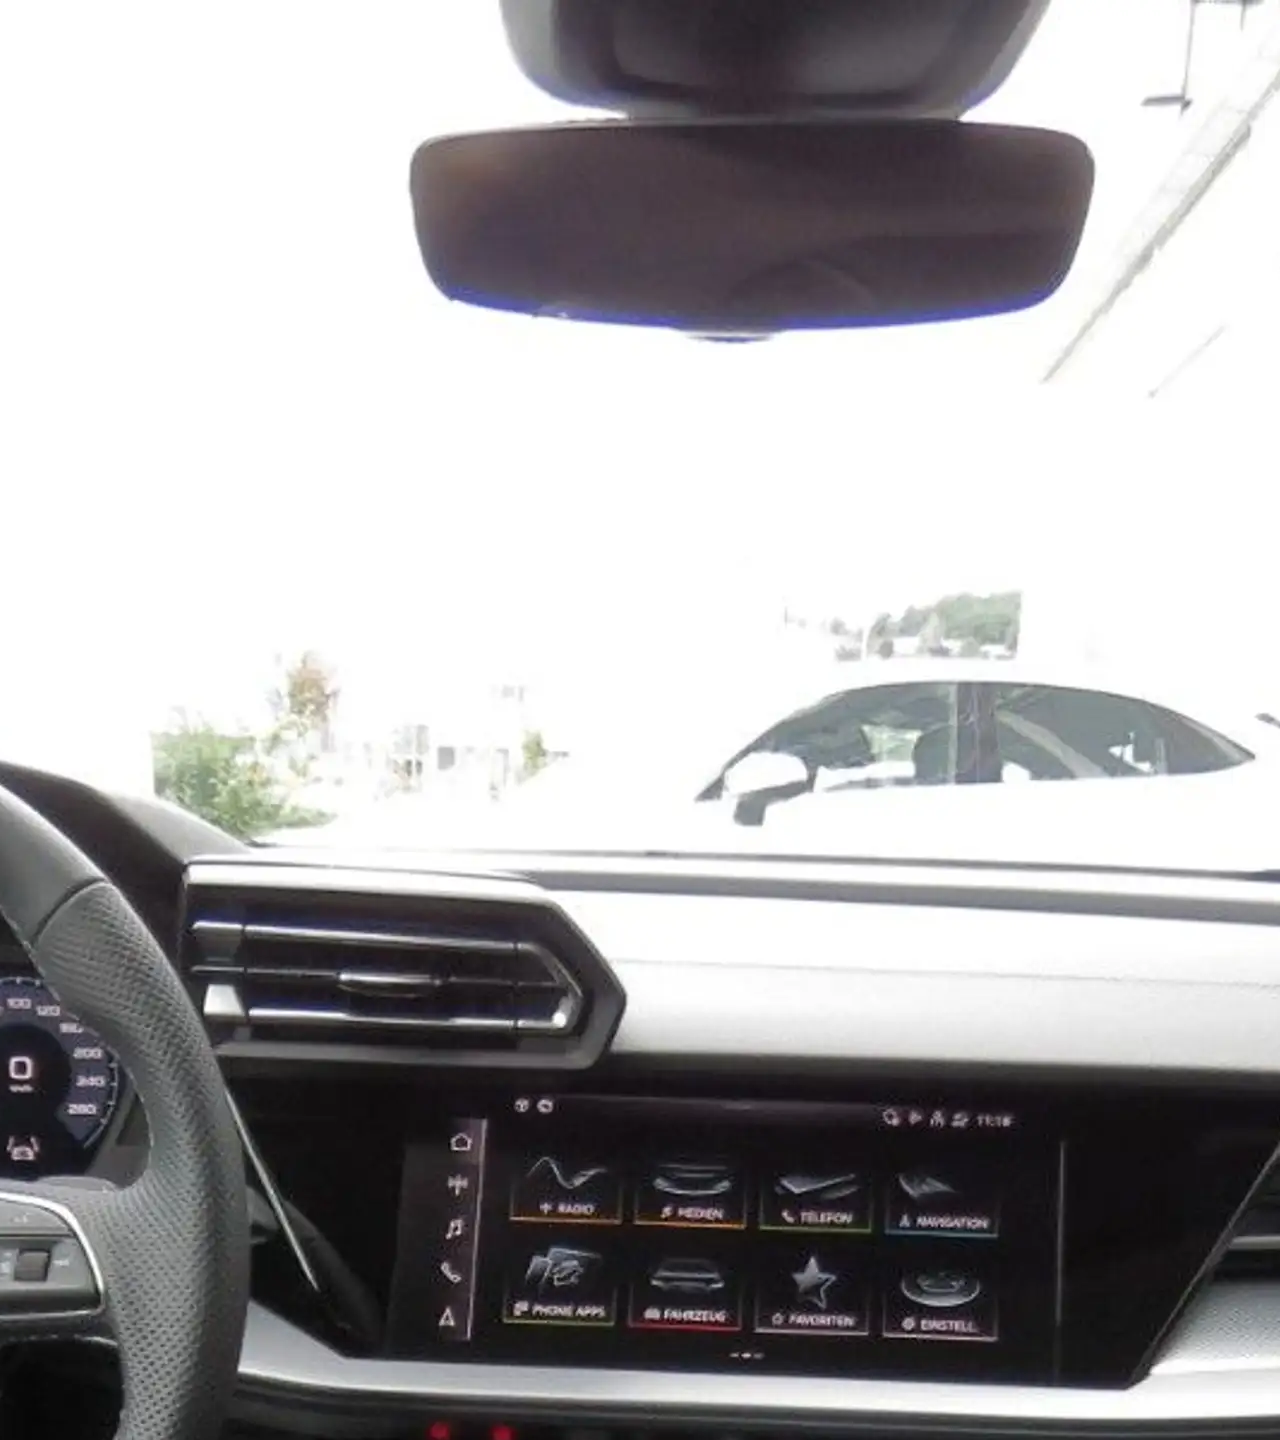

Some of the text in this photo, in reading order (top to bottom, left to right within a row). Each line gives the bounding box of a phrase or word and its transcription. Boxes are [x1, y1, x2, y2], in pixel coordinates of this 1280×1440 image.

[6, 998, 32, 1010] 100
[36, 1005, 61, 1017] 120
[73, 1048, 103, 1060] 200
[7, 1055, 35, 1081] 0
[76, 1076, 106, 1088] 240
[558, 1202, 596, 1216] RADIO
[677, 1206, 724, 1221] MEDIEN
[799, 1211, 853, 1225] TELEFON
[915, 1215, 988, 1230] NAVIGATION
[531, 1304, 607, 1319] PHONE APPS
[663, 1307, 727, 1323] FAHRZEUG
[788, 1315, 857, 1328] FAVORITEN
